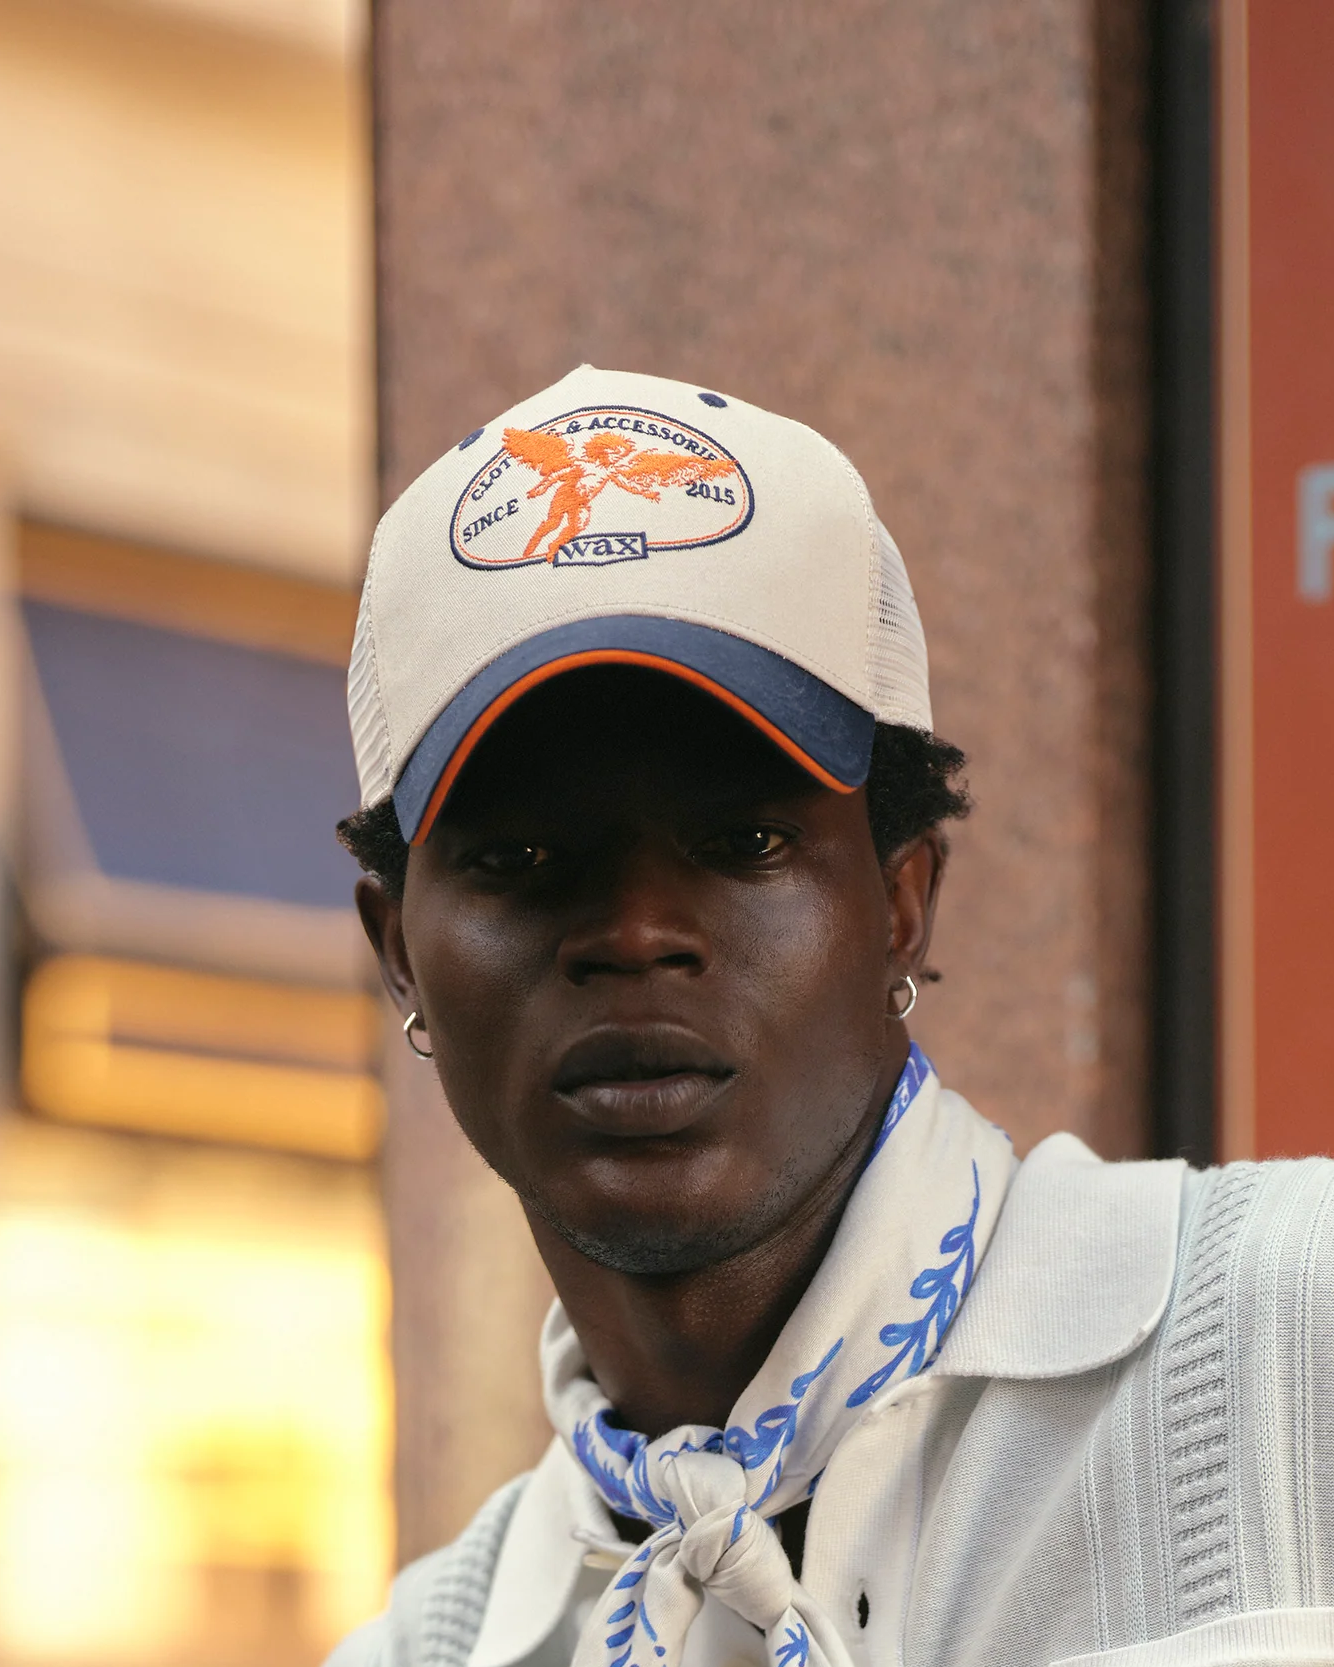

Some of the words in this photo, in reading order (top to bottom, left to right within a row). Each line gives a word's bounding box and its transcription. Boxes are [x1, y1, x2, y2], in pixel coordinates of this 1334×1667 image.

[463, 498, 519, 543] SINCE
[685, 480, 735, 505] 2015
[559, 538, 642, 560] wax
